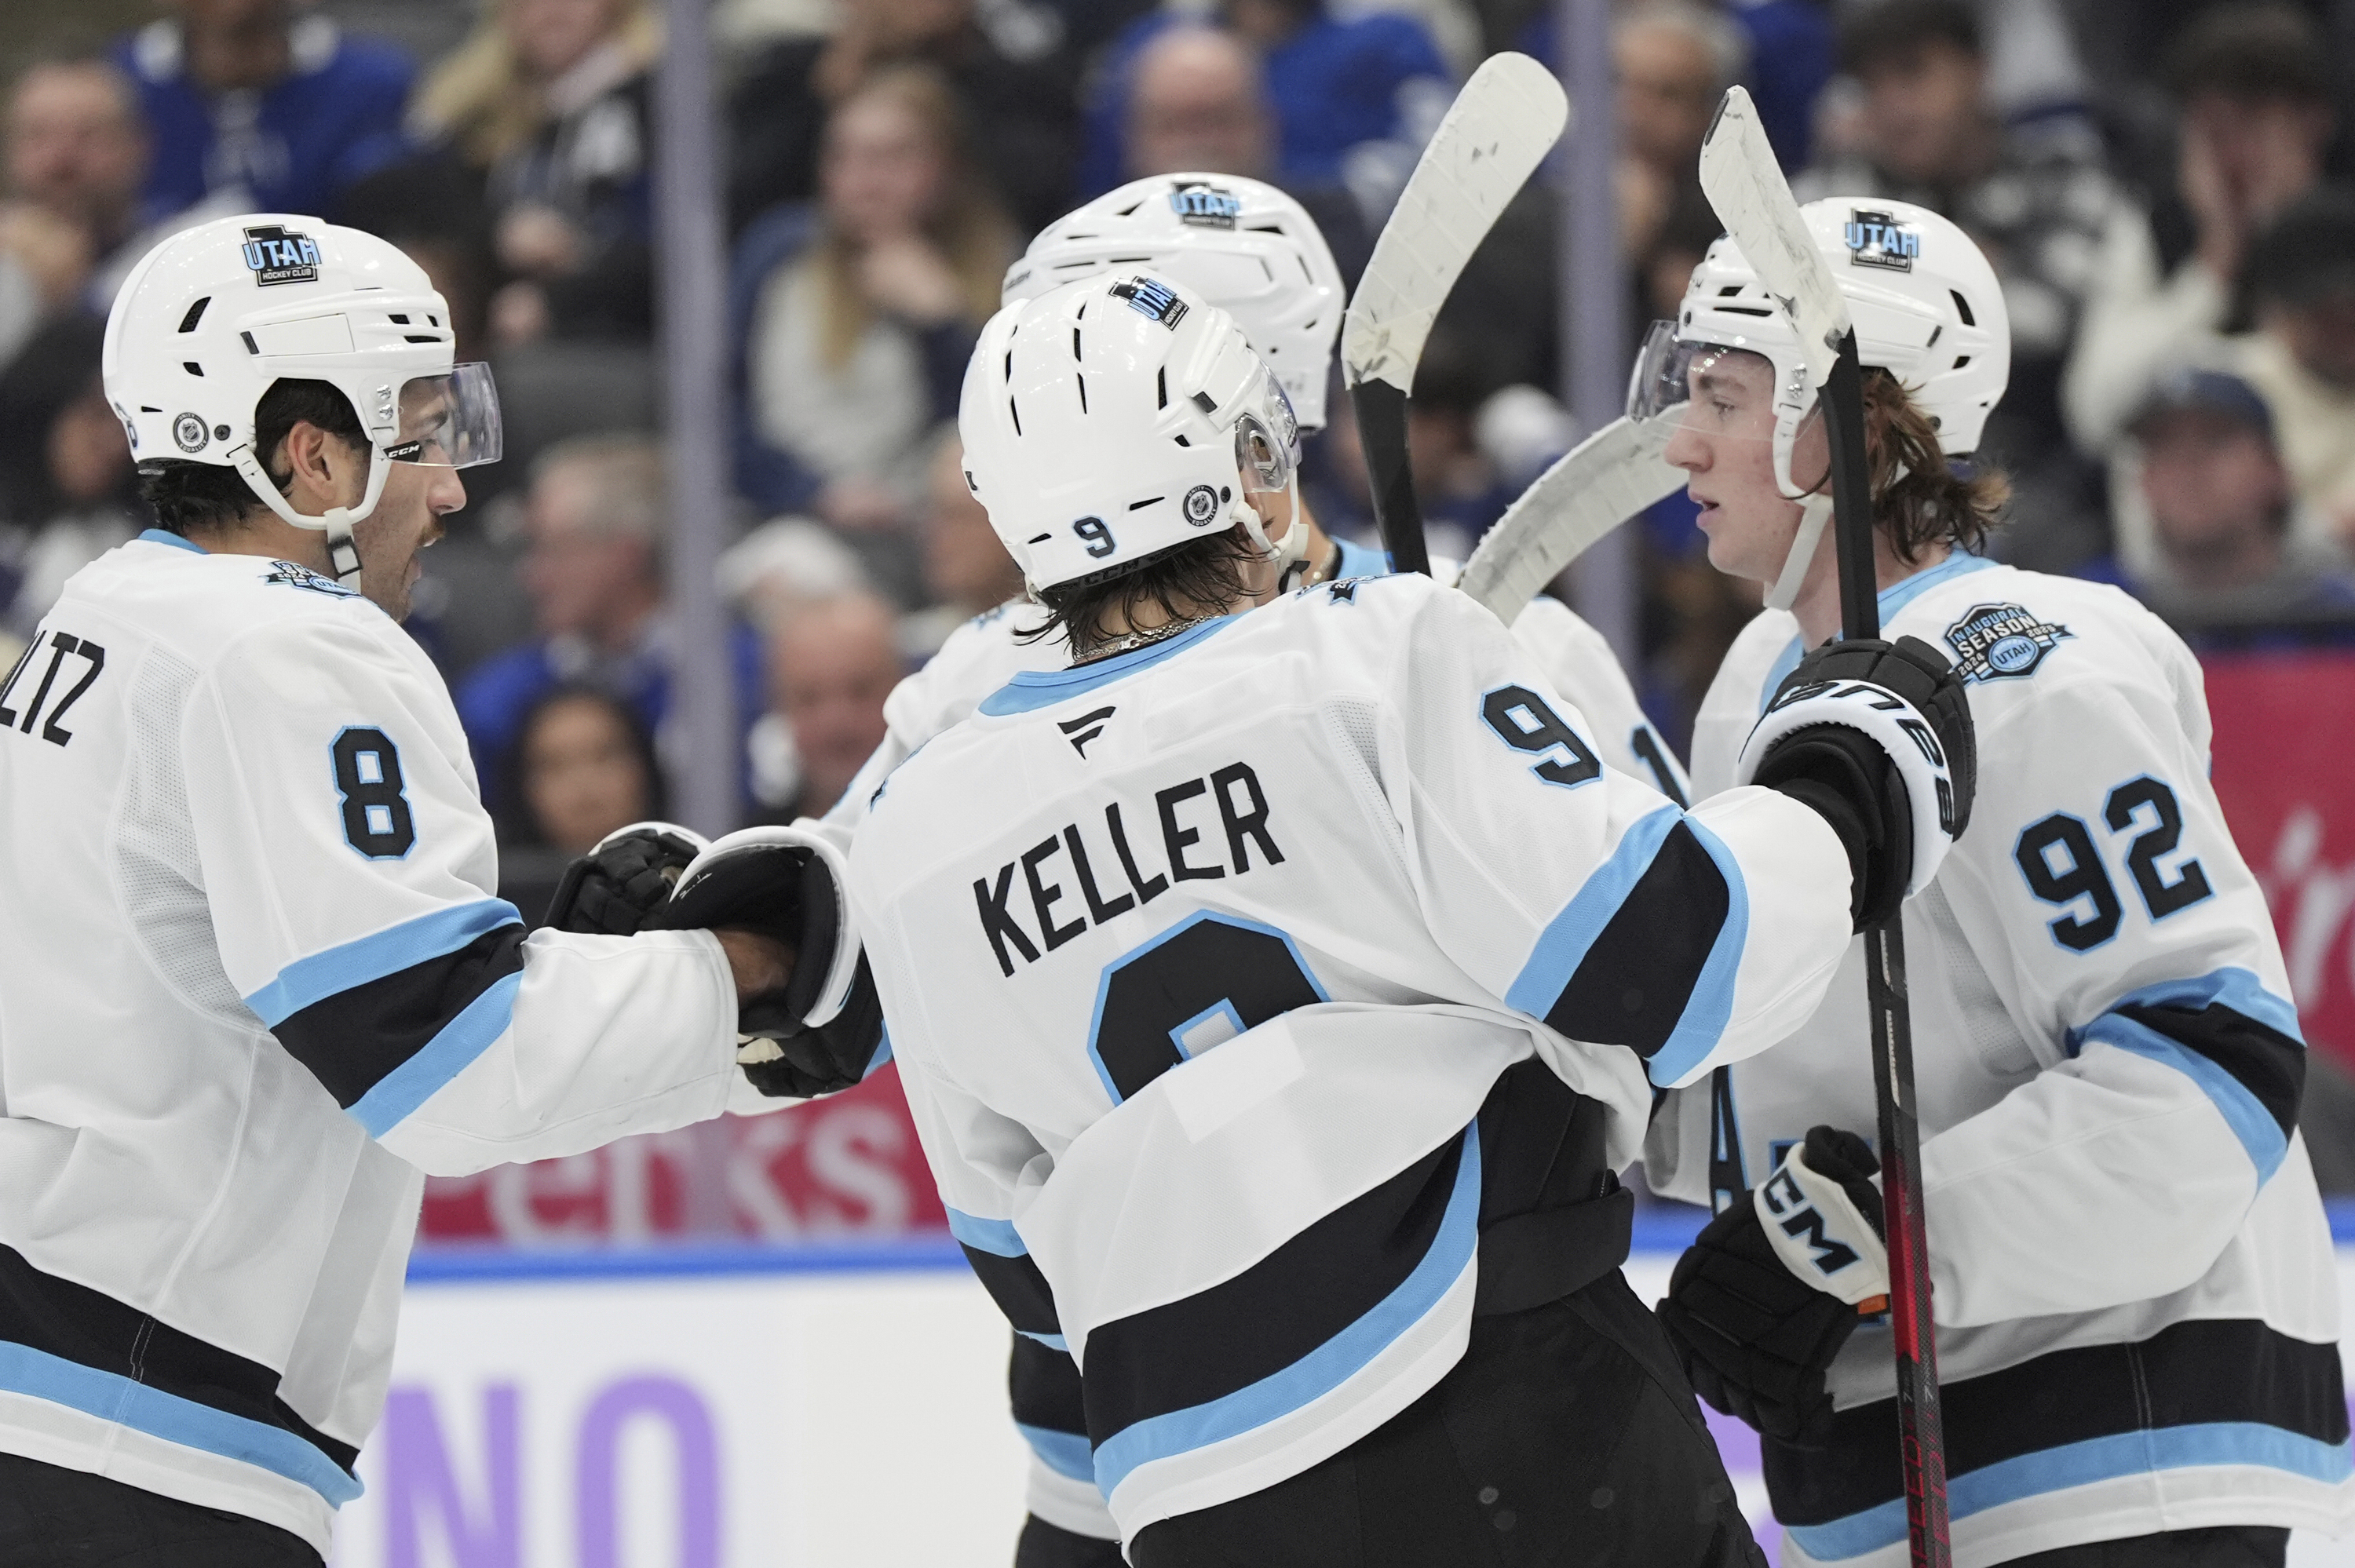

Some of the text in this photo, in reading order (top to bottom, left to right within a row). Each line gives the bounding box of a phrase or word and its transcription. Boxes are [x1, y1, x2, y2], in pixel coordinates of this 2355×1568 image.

[1168, 194, 1241, 218] UTAH
[242, 238, 322, 272] UTAH
[1845, 222, 1919, 258] UTAH
[262, 267, 312, 280] HOCKEY CLUB
[1126, 278, 1177, 321] UTAH
[388, 444, 421, 458] CCM
[1072, 515, 1117, 560] 9
[1950, 607, 2028, 646] INAUGURAL
[1957, 615, 2038, 659] SEASON
[1957, 652, 1985, 676] 2024
[1995, 642, 2032, 666] UTAH
[1479, 682, 1604, 790] 9
[327, 724, 418, 862] 8
[973, 761, 1286, 978] KELLER
[2010, 771, 2217, 957] 92
